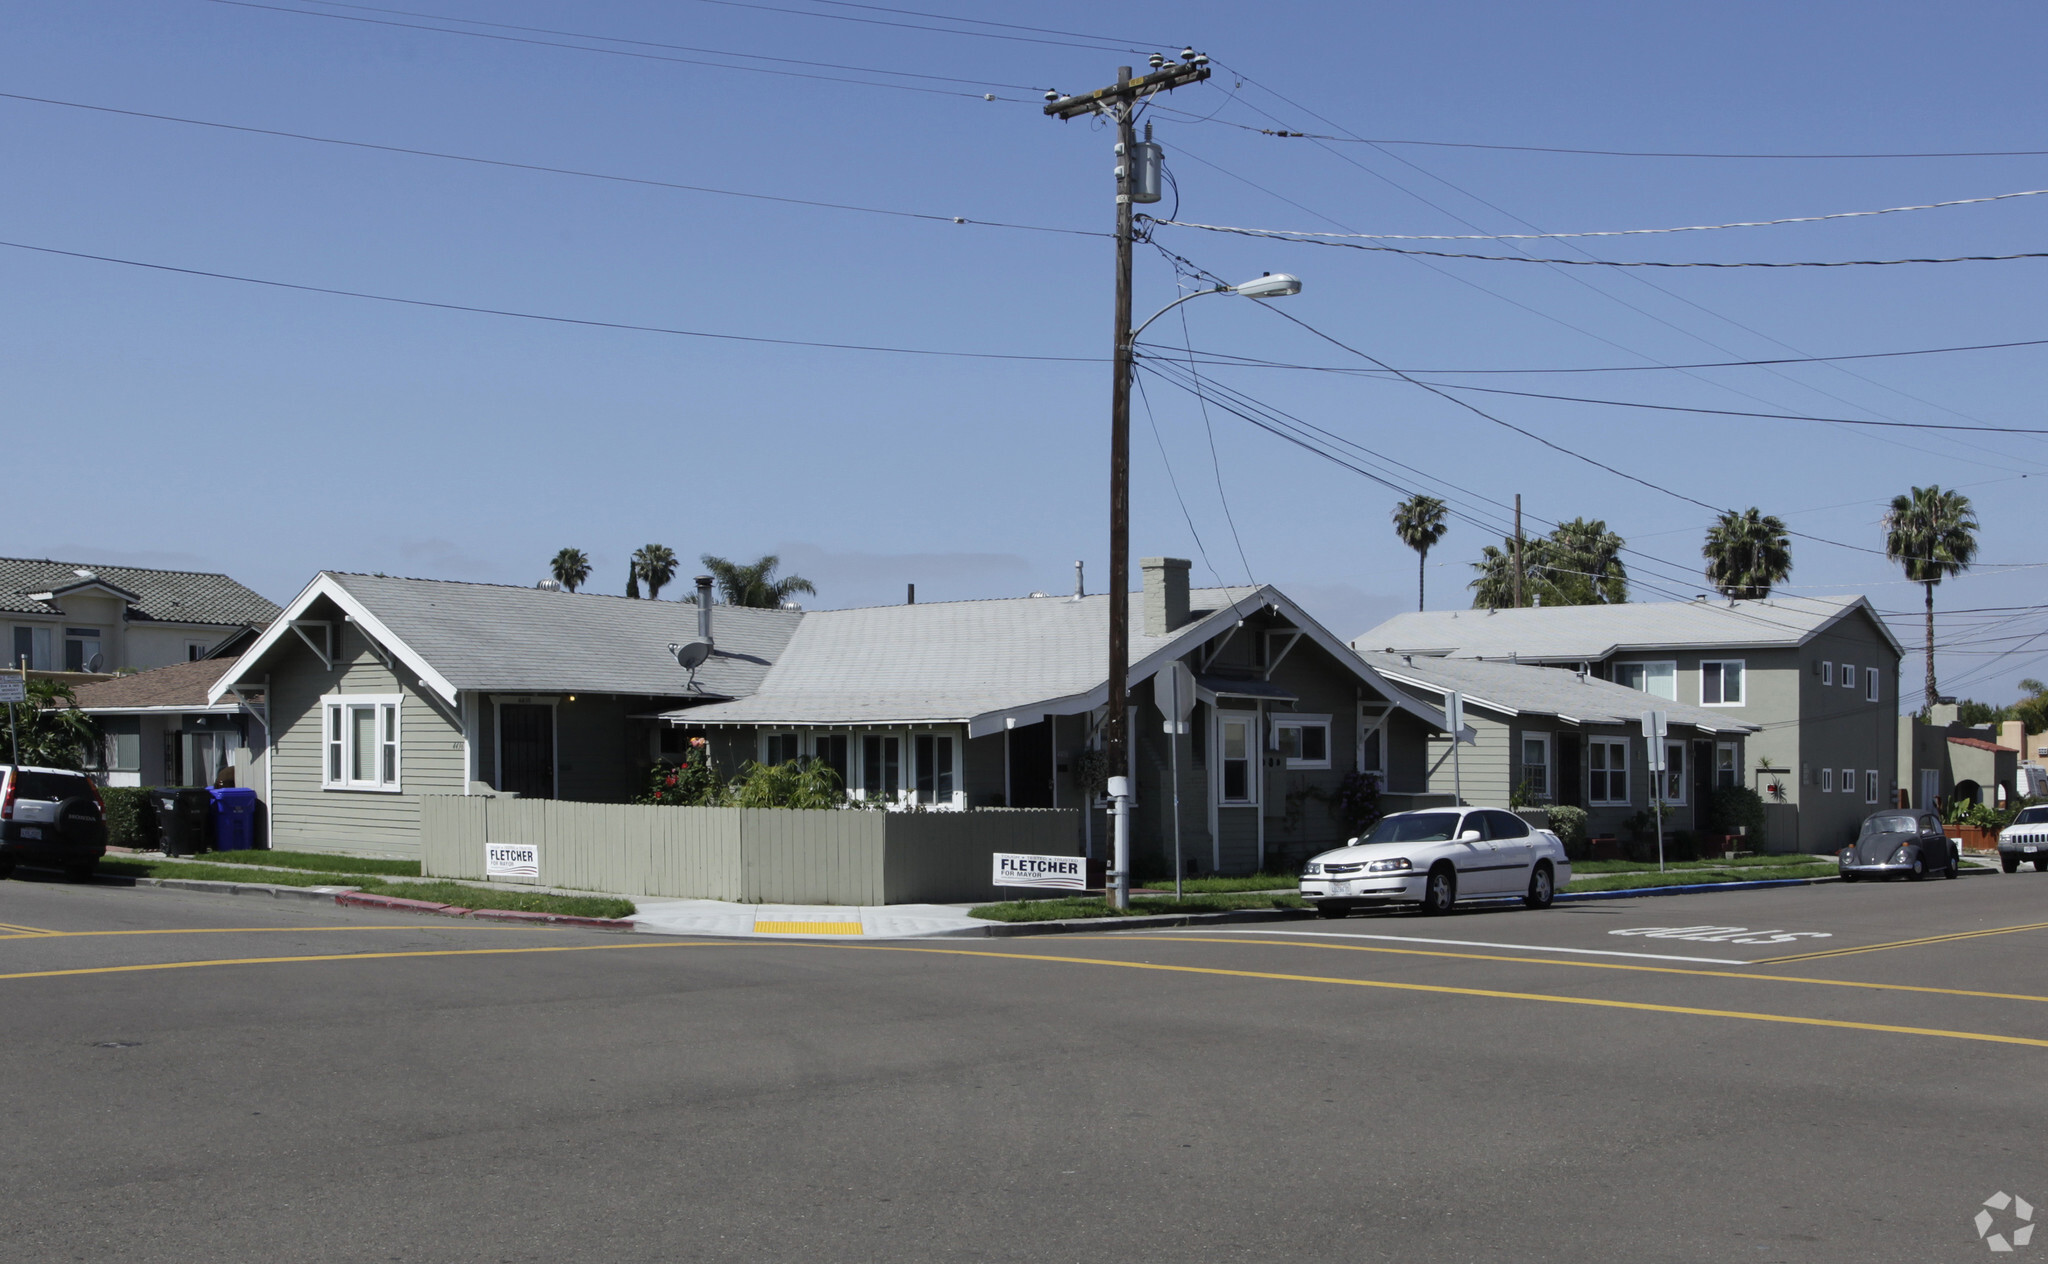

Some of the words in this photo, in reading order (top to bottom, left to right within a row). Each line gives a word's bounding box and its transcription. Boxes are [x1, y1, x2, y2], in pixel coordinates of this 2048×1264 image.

[68, 814, 97, 822] HONDA
[490, 849, 533, 862] FLETCHER
[1001, 858, 1078, 875] FLETCHER
[1608, 925, 1833, 944] STOP
